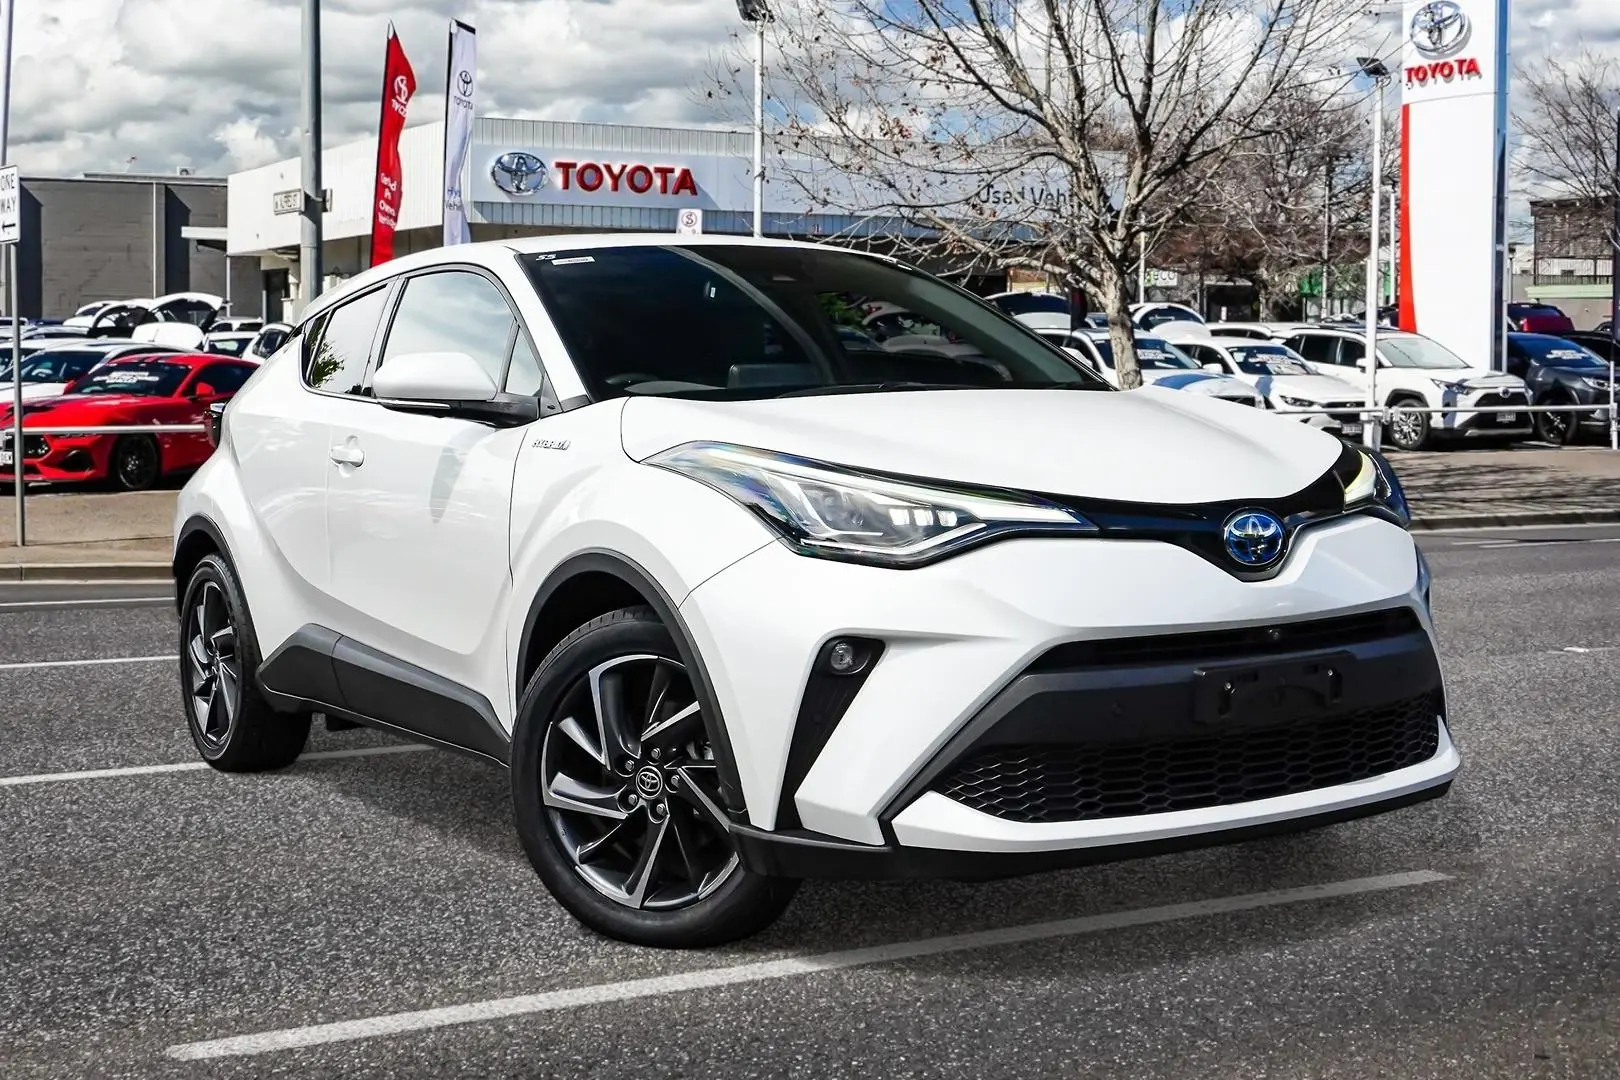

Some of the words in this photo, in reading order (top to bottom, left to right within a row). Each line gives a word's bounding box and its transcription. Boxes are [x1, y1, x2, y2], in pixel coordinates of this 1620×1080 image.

[1404, 58, 1481, 83] TOYOTA
[1, 173, 15, 191] ONE
[554, 161, 698, 196] TOYOTA
[1, 196, 16, 214] WAY
[531, 439, 571, 451] HYBRID
